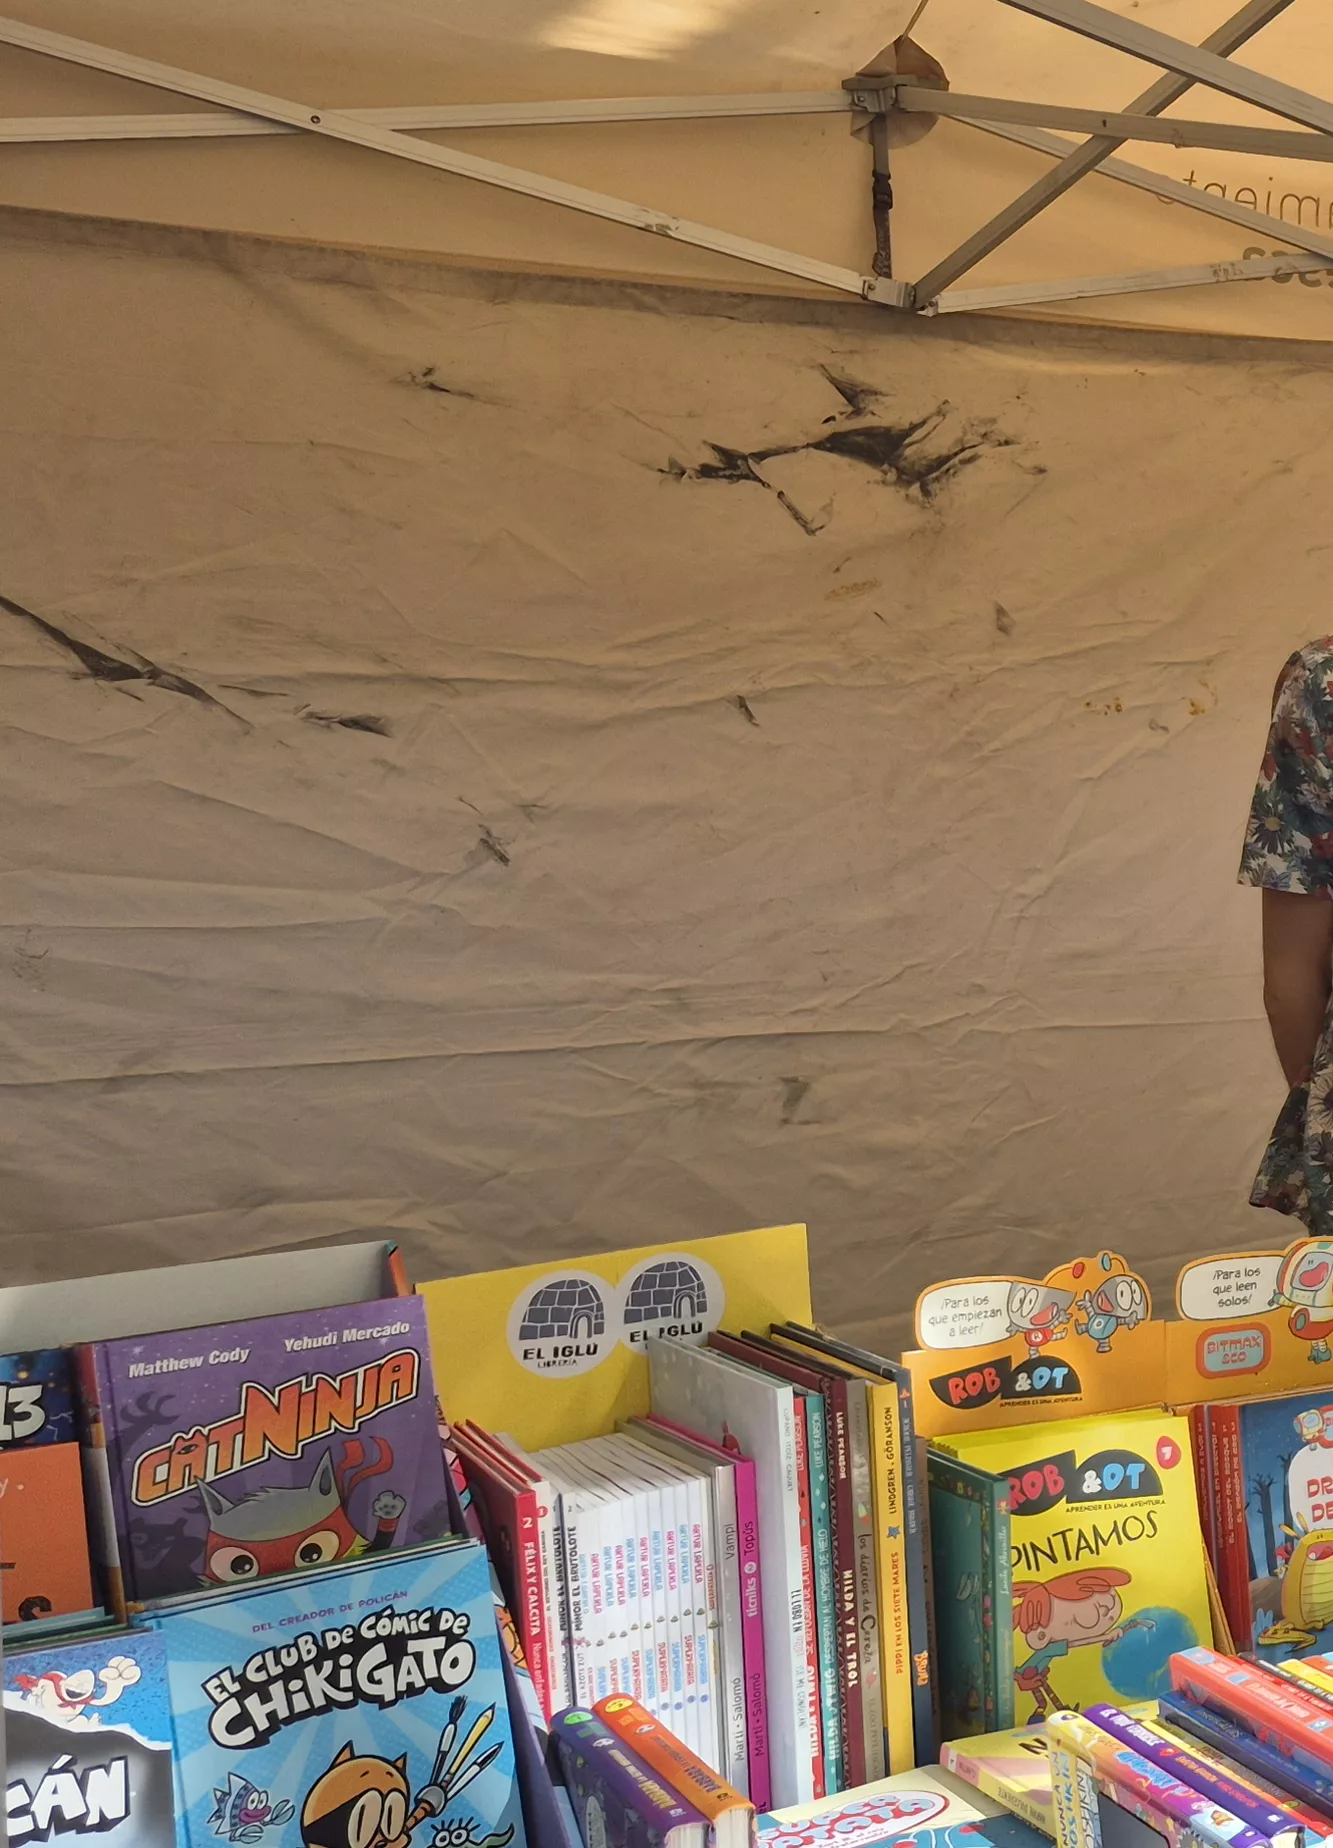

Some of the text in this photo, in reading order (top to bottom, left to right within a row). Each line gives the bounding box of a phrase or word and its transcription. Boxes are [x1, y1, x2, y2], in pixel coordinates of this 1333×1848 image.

[1212, 1282, 1257, 1295] que leen
[1245, 1267, 1261, 1277] los
[973, 1296, 990, 1306] los
[928, 1309, 1003, 1327] que empiezan
[949, 1327, 956, 1337] a
[284, 1321, 411, 1354] Yehudi Mercado
[523, 1347, 545, 1361] EL
[1207, 1336, 1261, 1355] BITMAX
[129, 1347, 251, 1379] Matthew Cody
[948, 1367, 1001, 1405] ROB
[811, 1411, 823, 1449] PEARSON
[1008, 1464, 1065, 1511] ROB
[1065, 1504, 1103, 1513] APRENDER
[1130, 1499, 1166, 1509] AVENTURA
[567, 1526, 579, 1582] BRUTOLOTE
[836, 1411, 859, 1687] LUKE PEARSON HILDA Y EL TROL
[859, 1533, 872, 1549] los
[883, 1406, 904, 1674] PIPPI LOS SIETE MARES LINDGREN GÖRANSON
[523, 1542, 537, 1574] FÉLIX
[860, 1554, 873, 1596] diarios
[252, 1590, 408, 1634] DEL CREADOR DE POLICÁN
[528, 1587, 542, 1638] CALCITA
[862, 1598, 873, 1613] de
[201, 1669, 240, 1702] EL
[245, 1633, 318, 1683] CLUB
[729, 1677, 743, 1721] Salomó
[758, 1795, 900, 1841] SUPER
